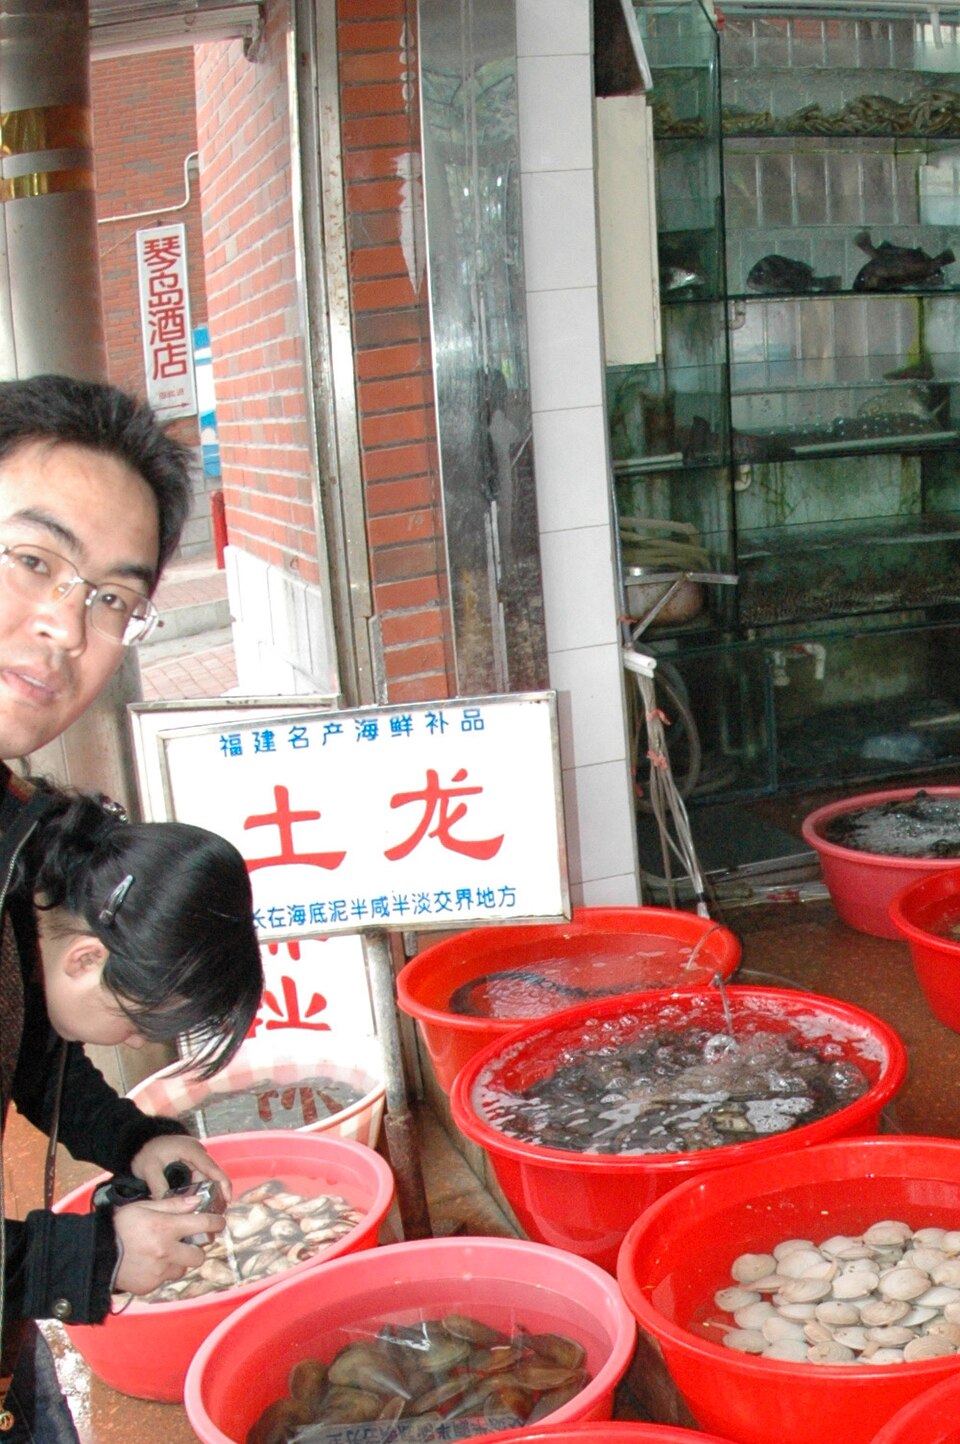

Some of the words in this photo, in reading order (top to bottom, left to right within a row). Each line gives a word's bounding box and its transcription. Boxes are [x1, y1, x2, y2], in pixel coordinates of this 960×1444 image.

[144, 235, 187, 381] 琴岛酒店
[219, 708, 485, 757] 福建名产海鲜补品
[243, 768, 505, 871] 土龙
